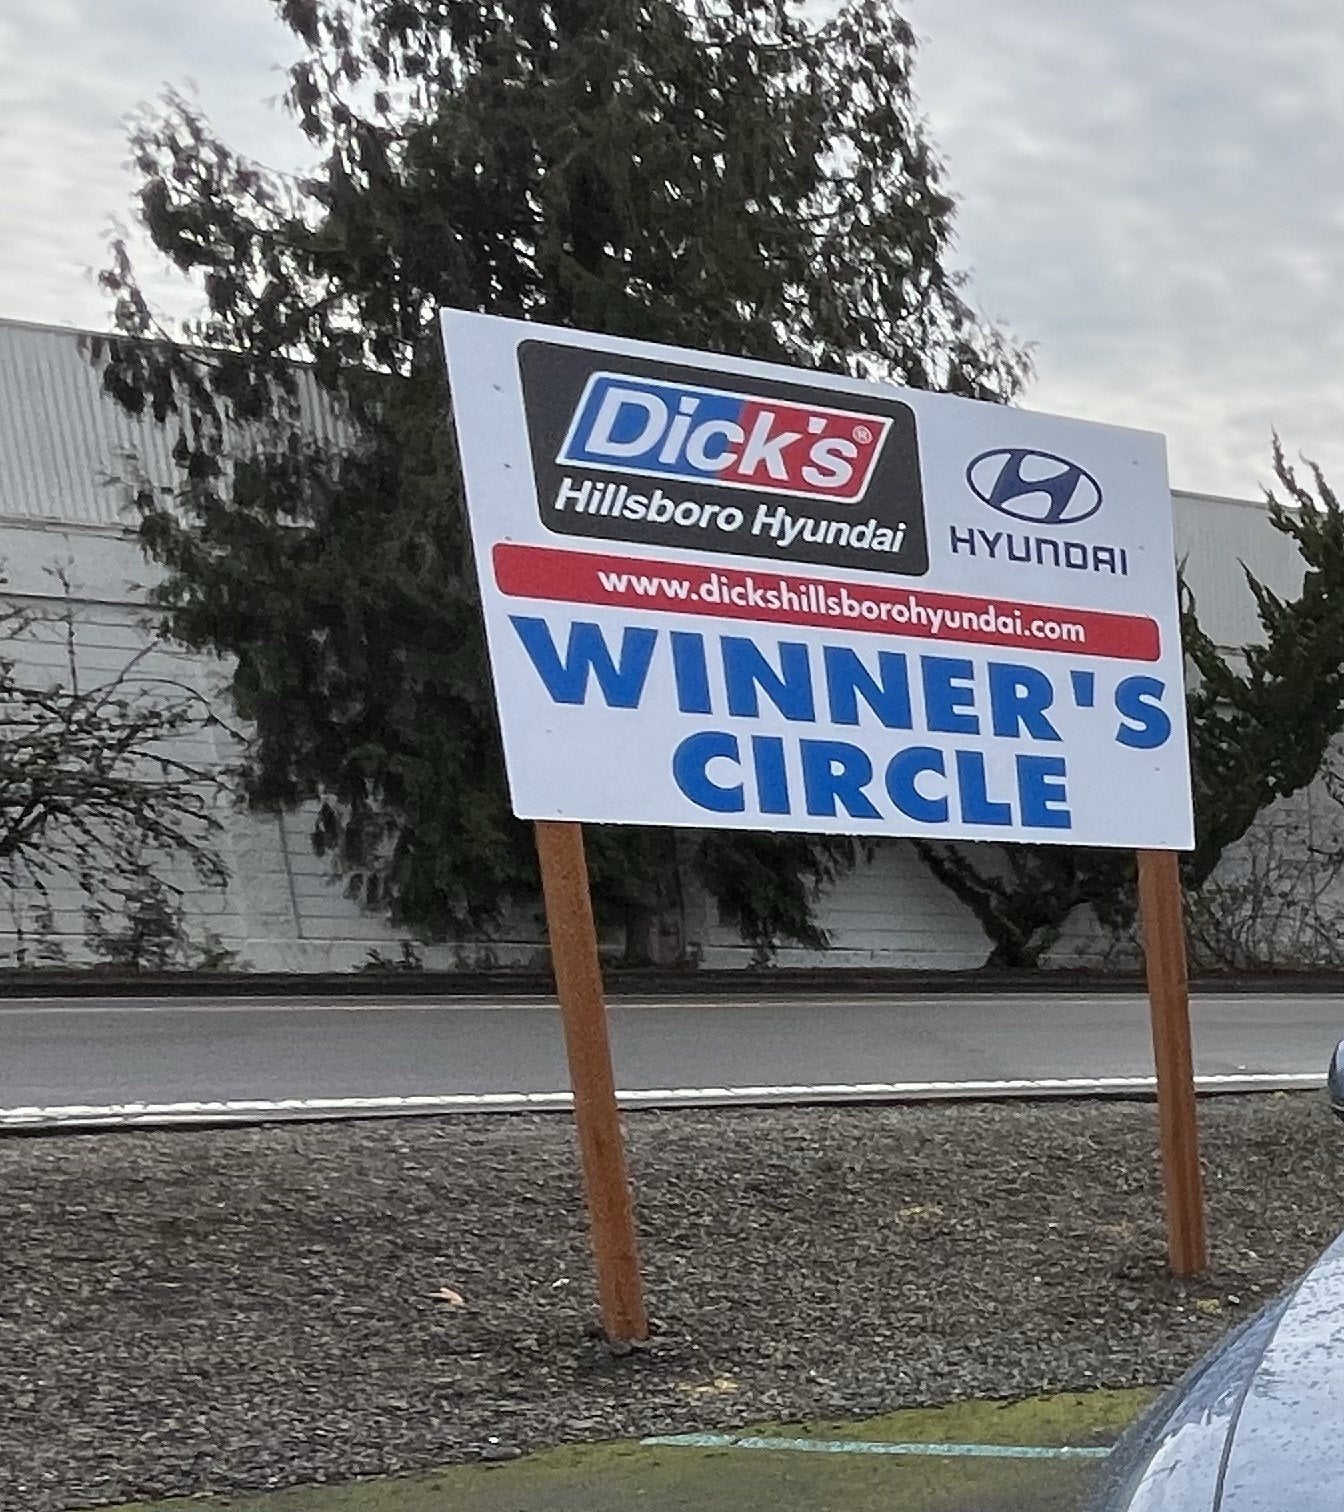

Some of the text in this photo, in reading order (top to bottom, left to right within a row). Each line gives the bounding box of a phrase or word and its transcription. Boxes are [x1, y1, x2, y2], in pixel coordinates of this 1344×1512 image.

[554, 477, 907, 554] Hillsboro Hyundai
[950, 525, 1128, 576] HYUNDAI
[598, 571, 1086, 643] www.dickshillsborohyundai.com
[509, 615, 1172, 750] WINNER'S
[672, 731, 1072, 830] CIRCLE
